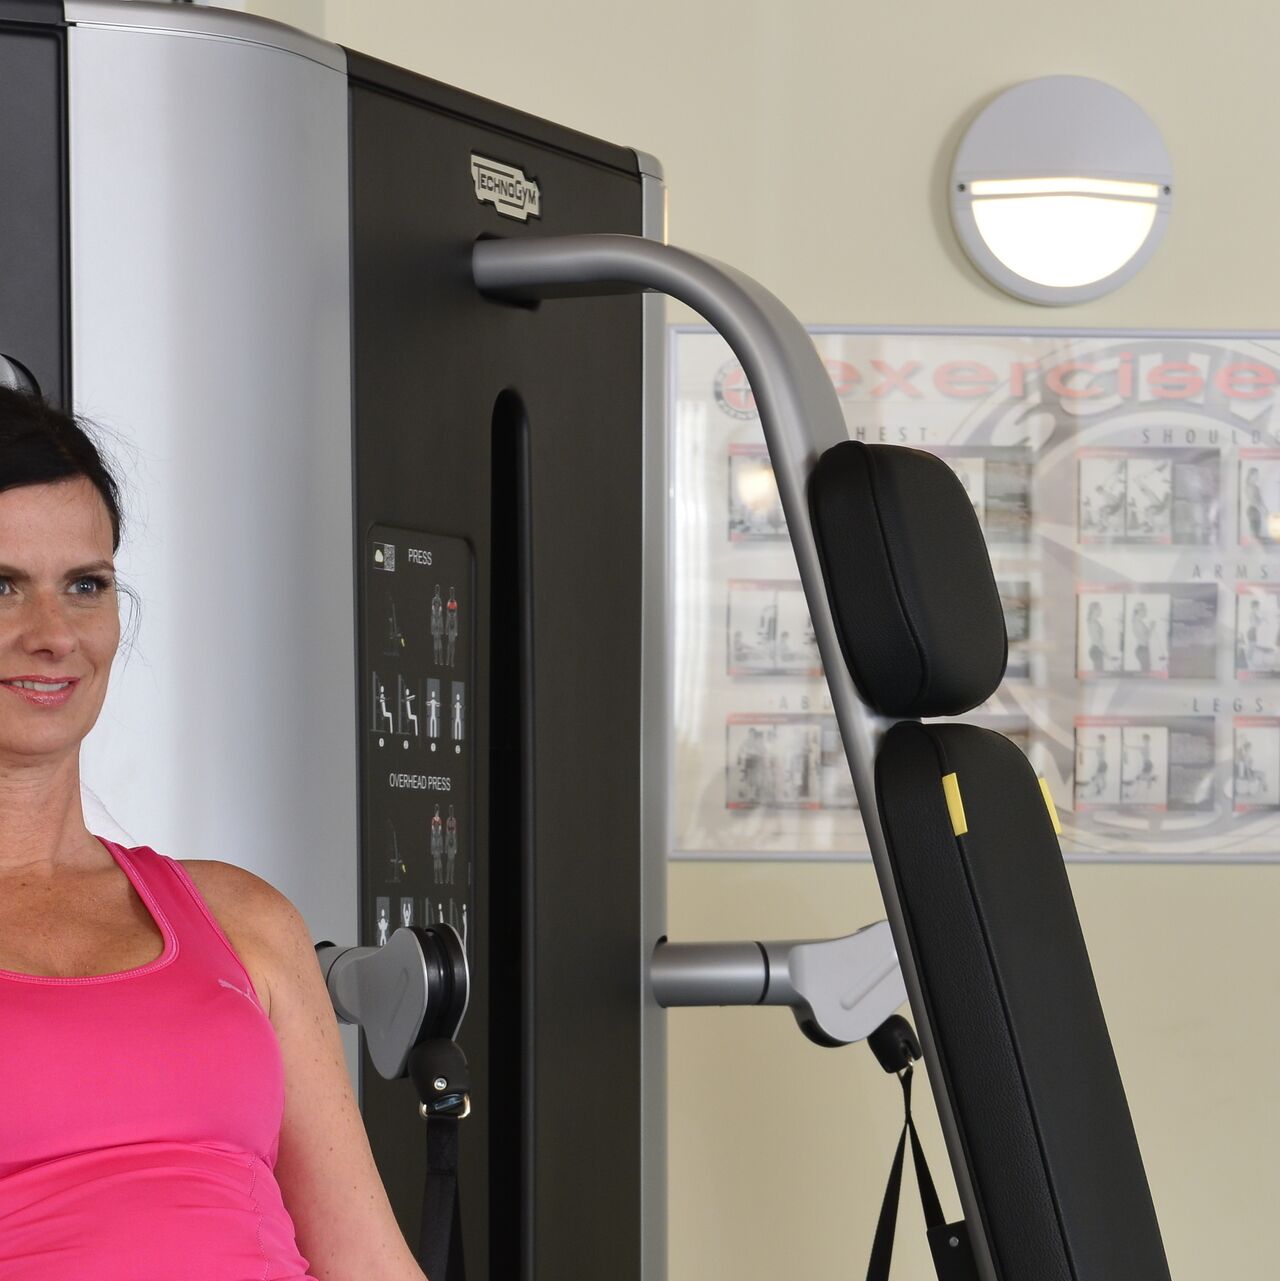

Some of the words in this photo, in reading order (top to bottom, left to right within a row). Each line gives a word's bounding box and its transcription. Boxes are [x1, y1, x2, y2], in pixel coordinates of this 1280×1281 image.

[855, 426, 927, 443] HEST
[407, 548, 432, 566] PRESS
[1192, 564, 1269, 579] ARMS
[1192, 697, 1264, 712] LEGS
[389, 773, 427, 790] OVERHEAD
[427, 776, 452, 792] PRESS
